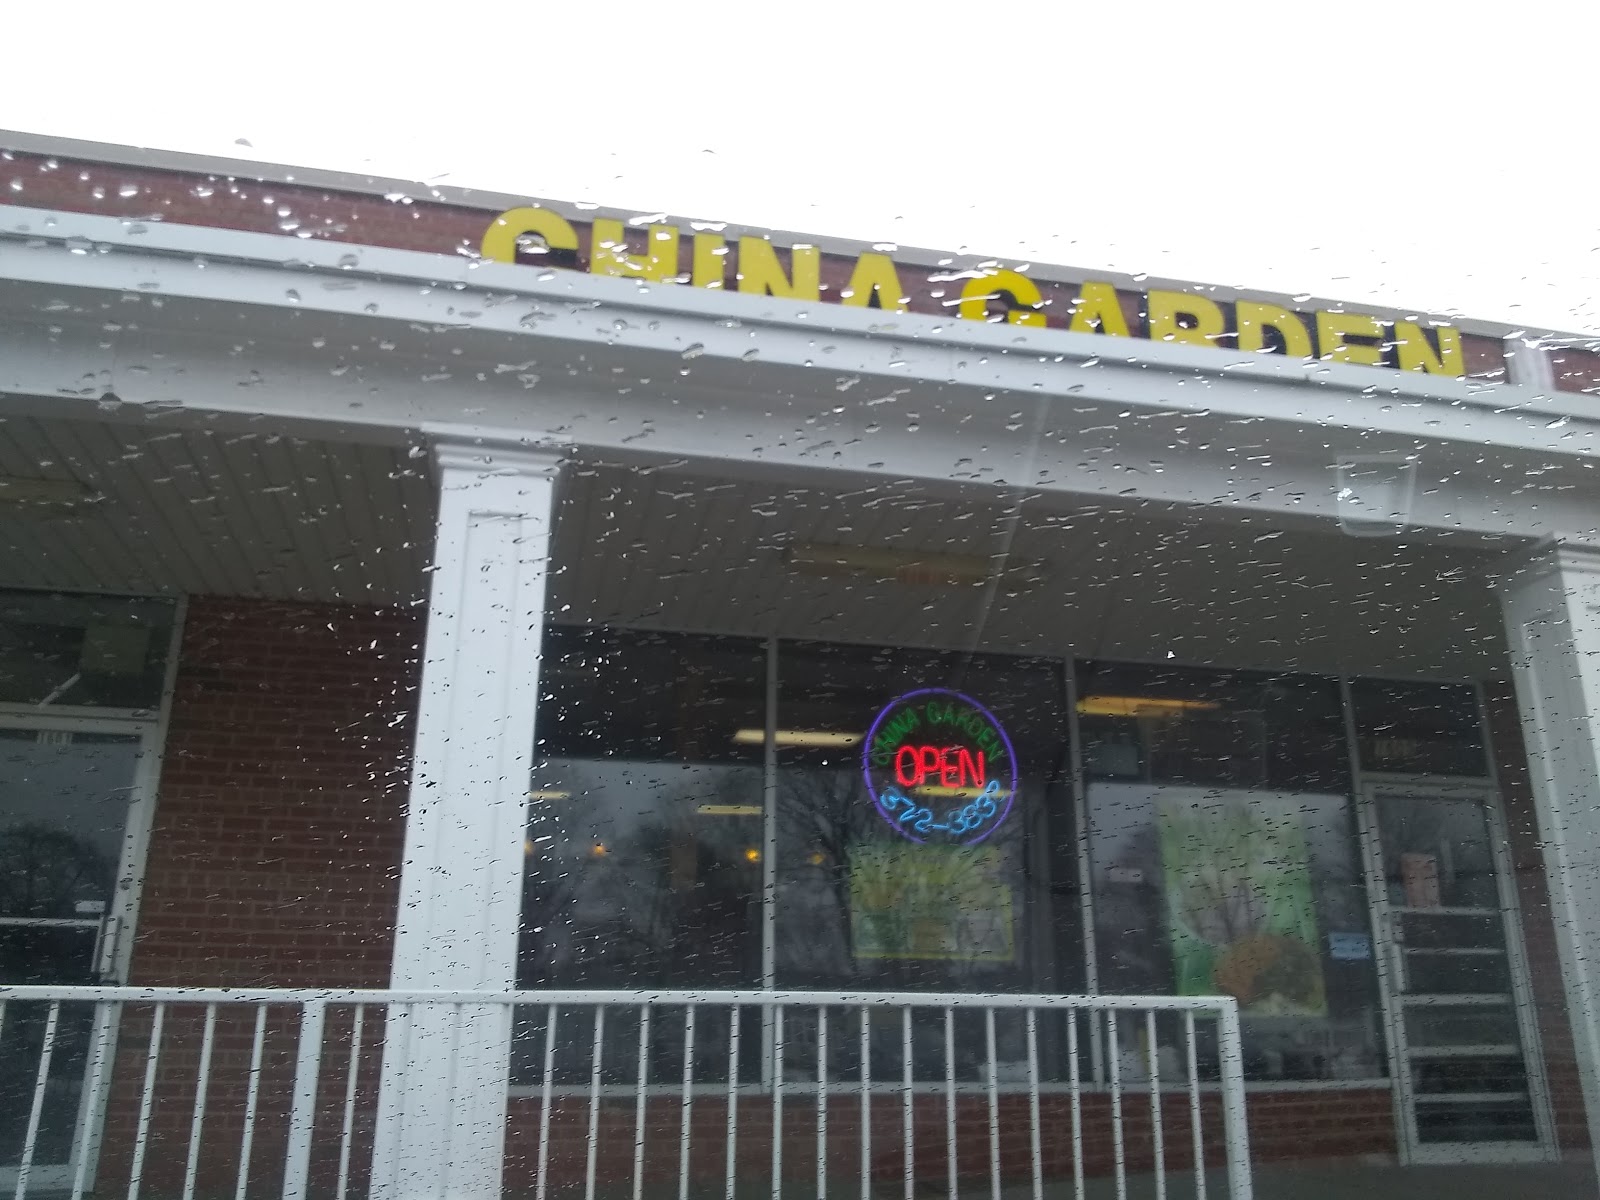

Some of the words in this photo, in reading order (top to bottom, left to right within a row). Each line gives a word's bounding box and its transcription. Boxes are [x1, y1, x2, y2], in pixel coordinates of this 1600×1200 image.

[481, 207, 908, 312] CHINA
[959, 268, 1465, 377] GARDEN
[895, 745, 986, 788] OPEN
